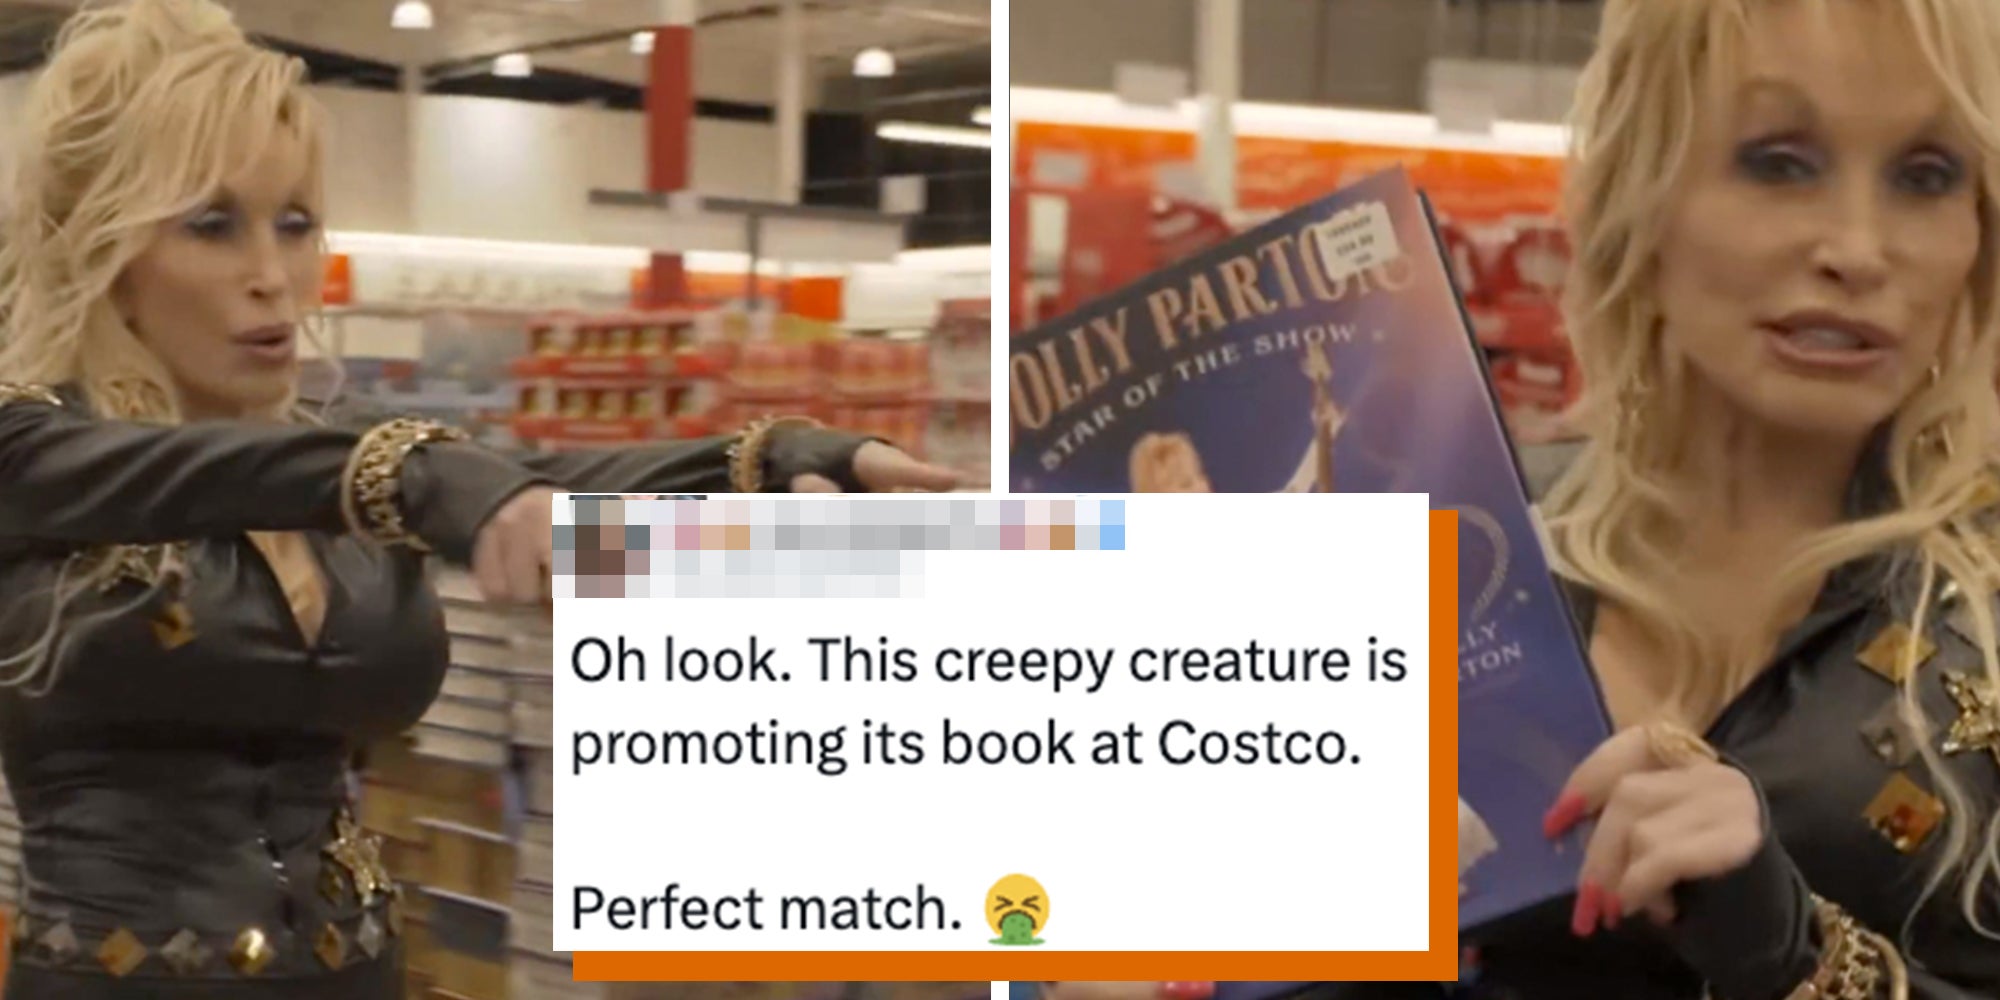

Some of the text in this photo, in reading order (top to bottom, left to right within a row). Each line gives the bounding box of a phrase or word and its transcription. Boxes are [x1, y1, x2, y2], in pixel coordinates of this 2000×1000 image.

[1009, 306, 1131, 448] OLLY
[1040, 322, 1356, 471] STAR OF THE SHOW
